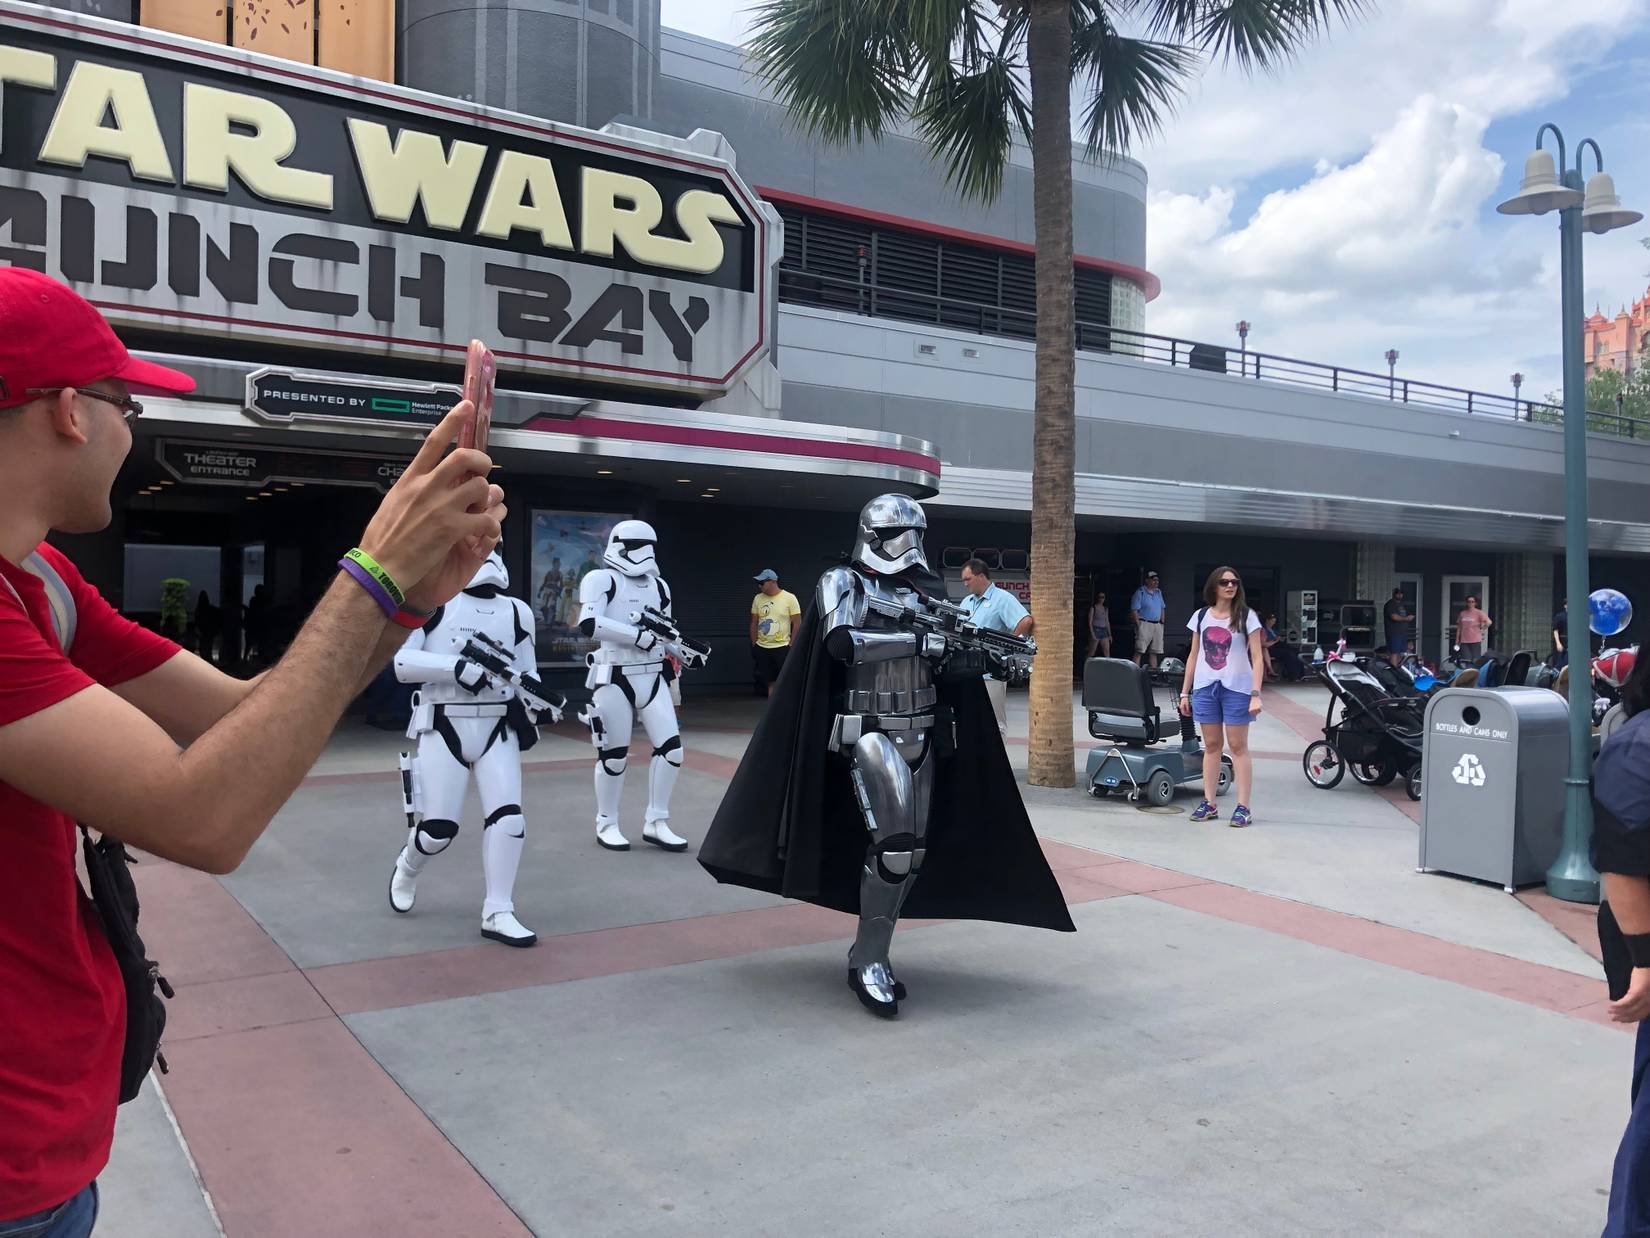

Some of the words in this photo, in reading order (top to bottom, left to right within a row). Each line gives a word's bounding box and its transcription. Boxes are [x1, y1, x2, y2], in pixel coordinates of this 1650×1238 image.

[346, 117, 747, 274] WARS
[485, 262, 710, 362] BAY
[264, 389, 345, 405] PRESENTED
[349, 397, 366, 407] BY
[1436, 722, 1458, 733] BOTTLES
[1459, 726, 1473, 735] AND
[1474, 728, 1491, 737] CANS
[1492, 730, 1509, 739] ONLY
